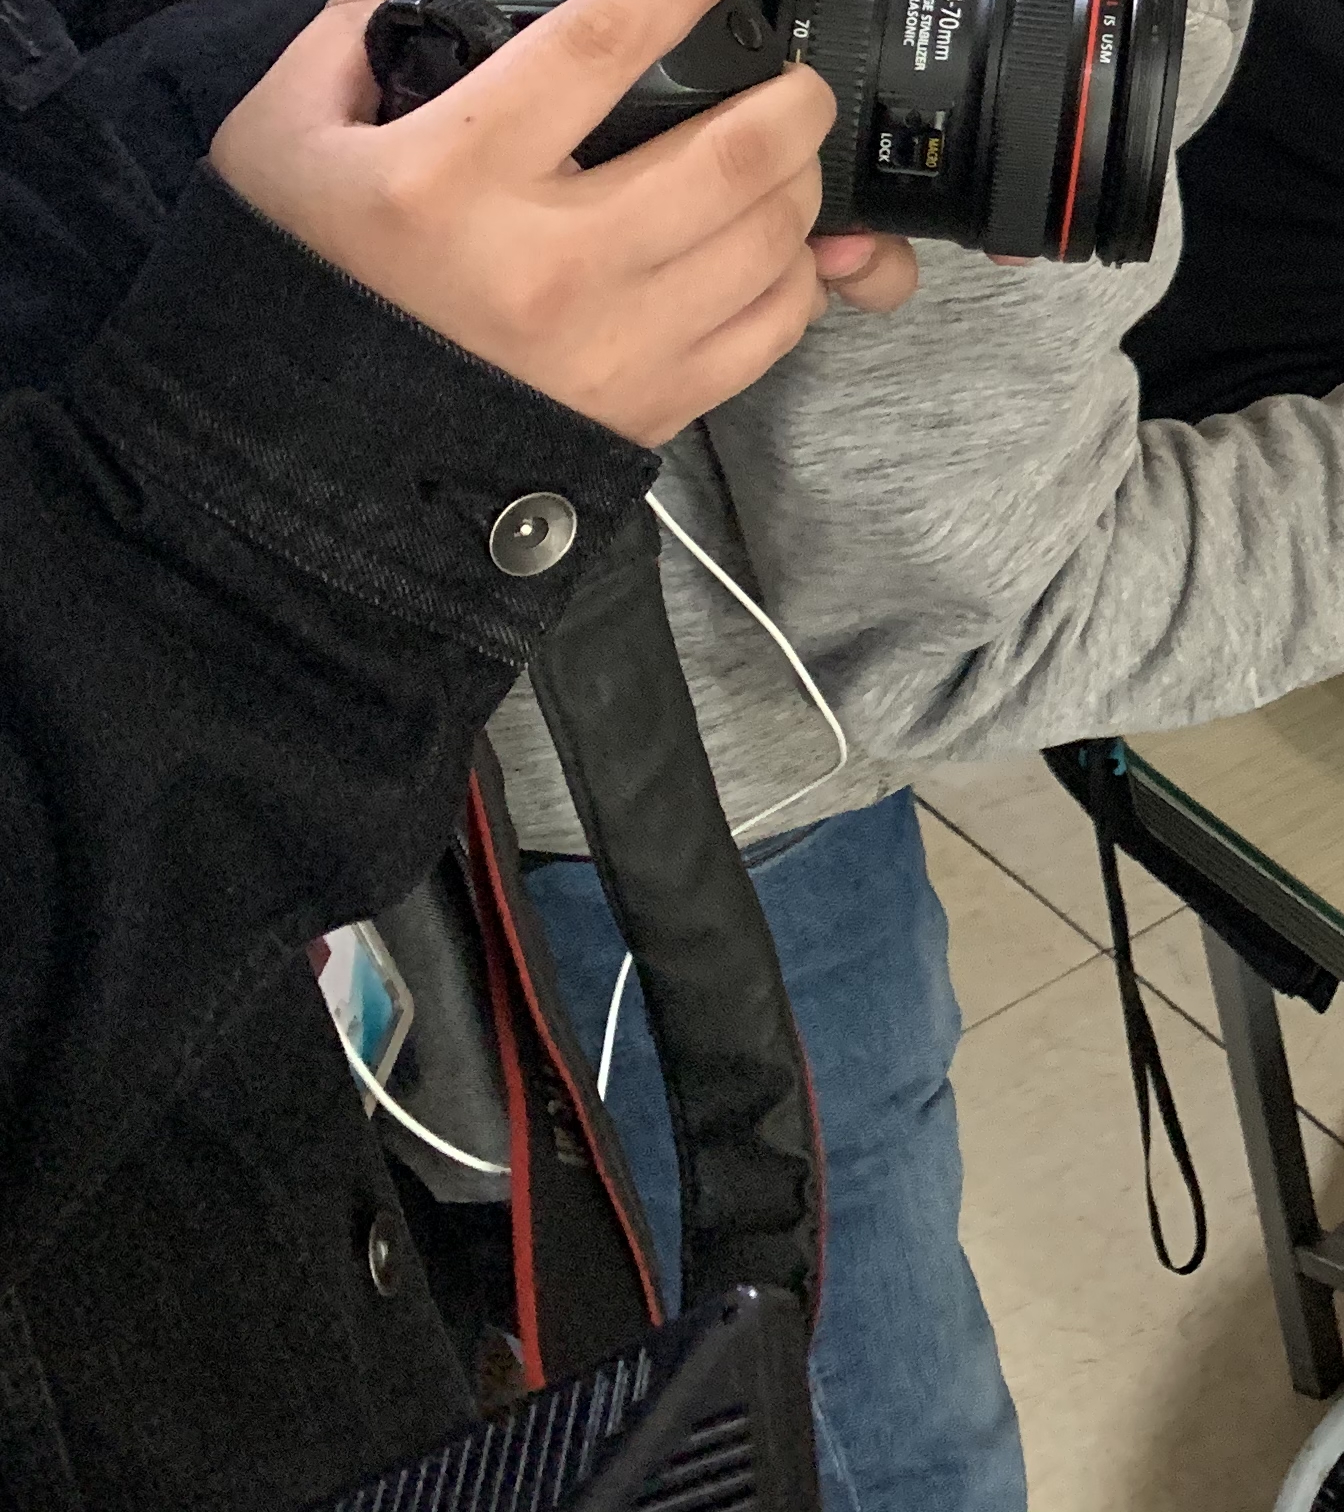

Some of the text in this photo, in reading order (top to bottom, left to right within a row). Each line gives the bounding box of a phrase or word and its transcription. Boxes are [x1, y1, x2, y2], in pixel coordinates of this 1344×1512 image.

[792, 18, 811, 39] 70
[1103, 14, 1117, 27] IS
[1098, 33, 1115, 65] USM
[877, 131, 893, 164] LOCK
